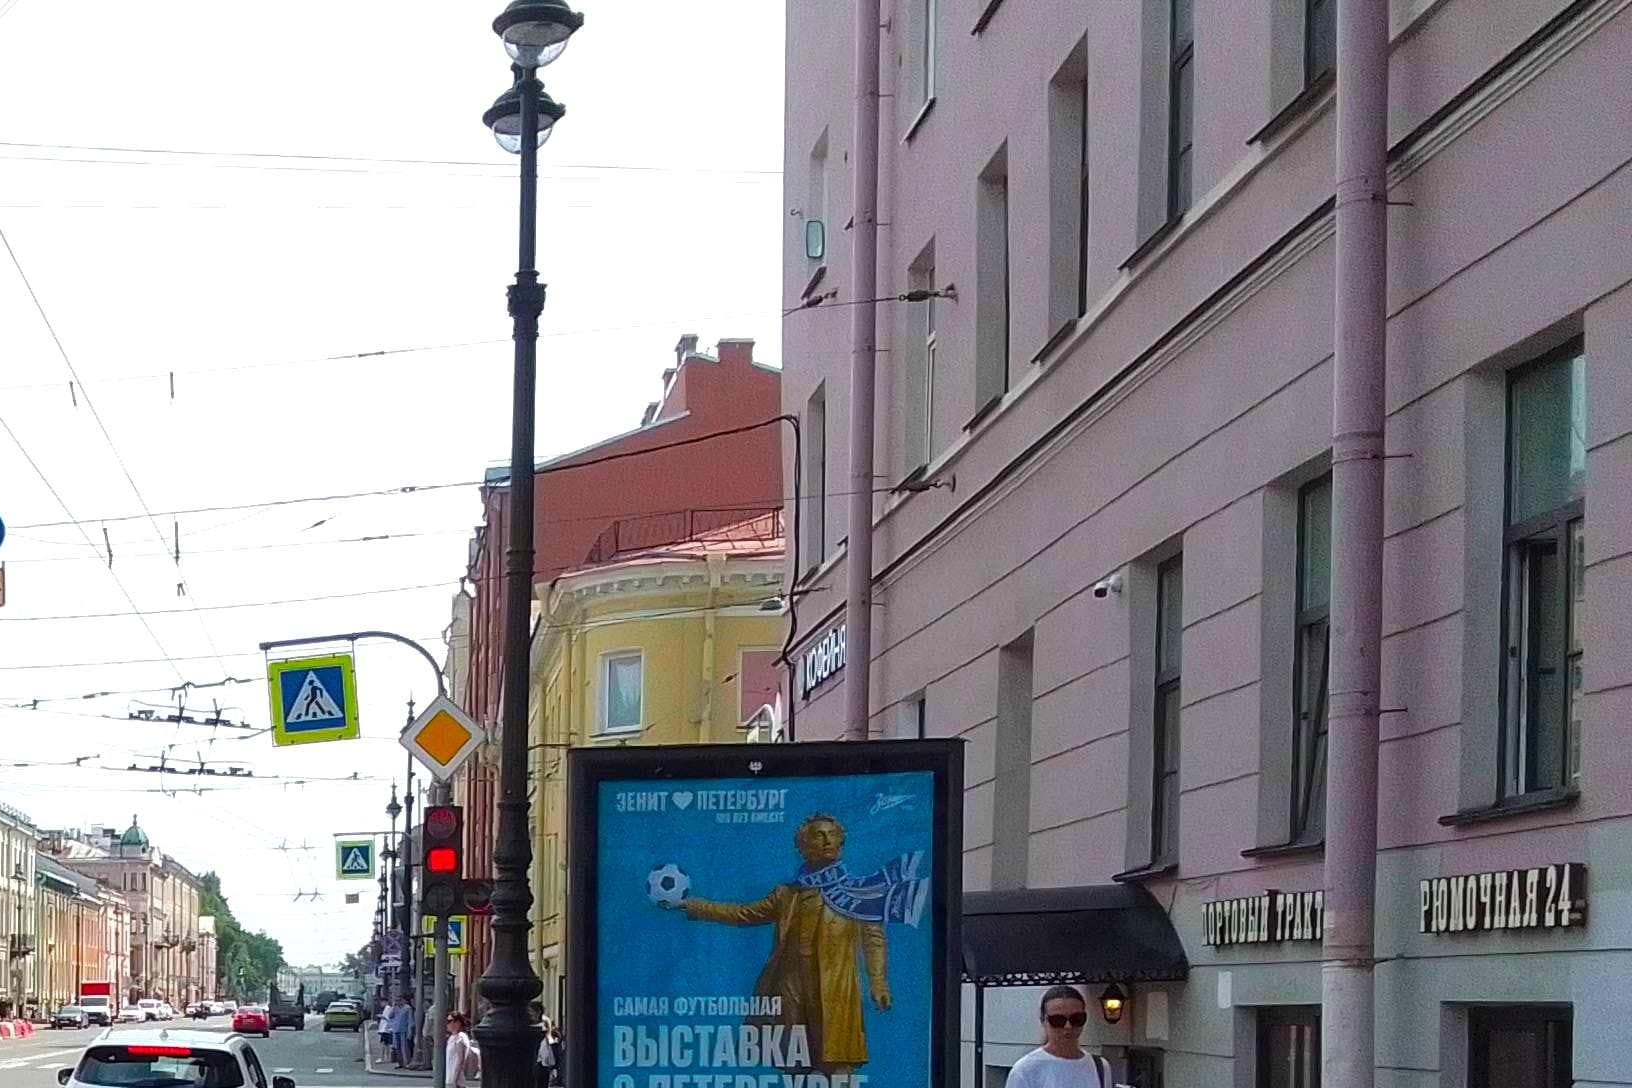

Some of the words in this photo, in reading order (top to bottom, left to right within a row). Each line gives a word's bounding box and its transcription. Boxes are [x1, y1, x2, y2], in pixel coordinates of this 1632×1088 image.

[616, 792, 668, 812] ЗЕНИТ
[697, 789, 789, 811] ПЕТЕРБУРГ
[1201, 890, 1270, 946] ПОРТОВЫЙ
[1276, 890, 1323, 941] ТРАКТ
[1419, 869, 1539, 933] РЮМОЧНАЯ
[1544, 863, 1571, 926] 24
[614, 996, 668, 1016] САМАЯ
[674, 996, 782, 1017] ФУТБОЛЬНАЯ
[613, 1024, 812, 1068] ВЫСТАВКА
